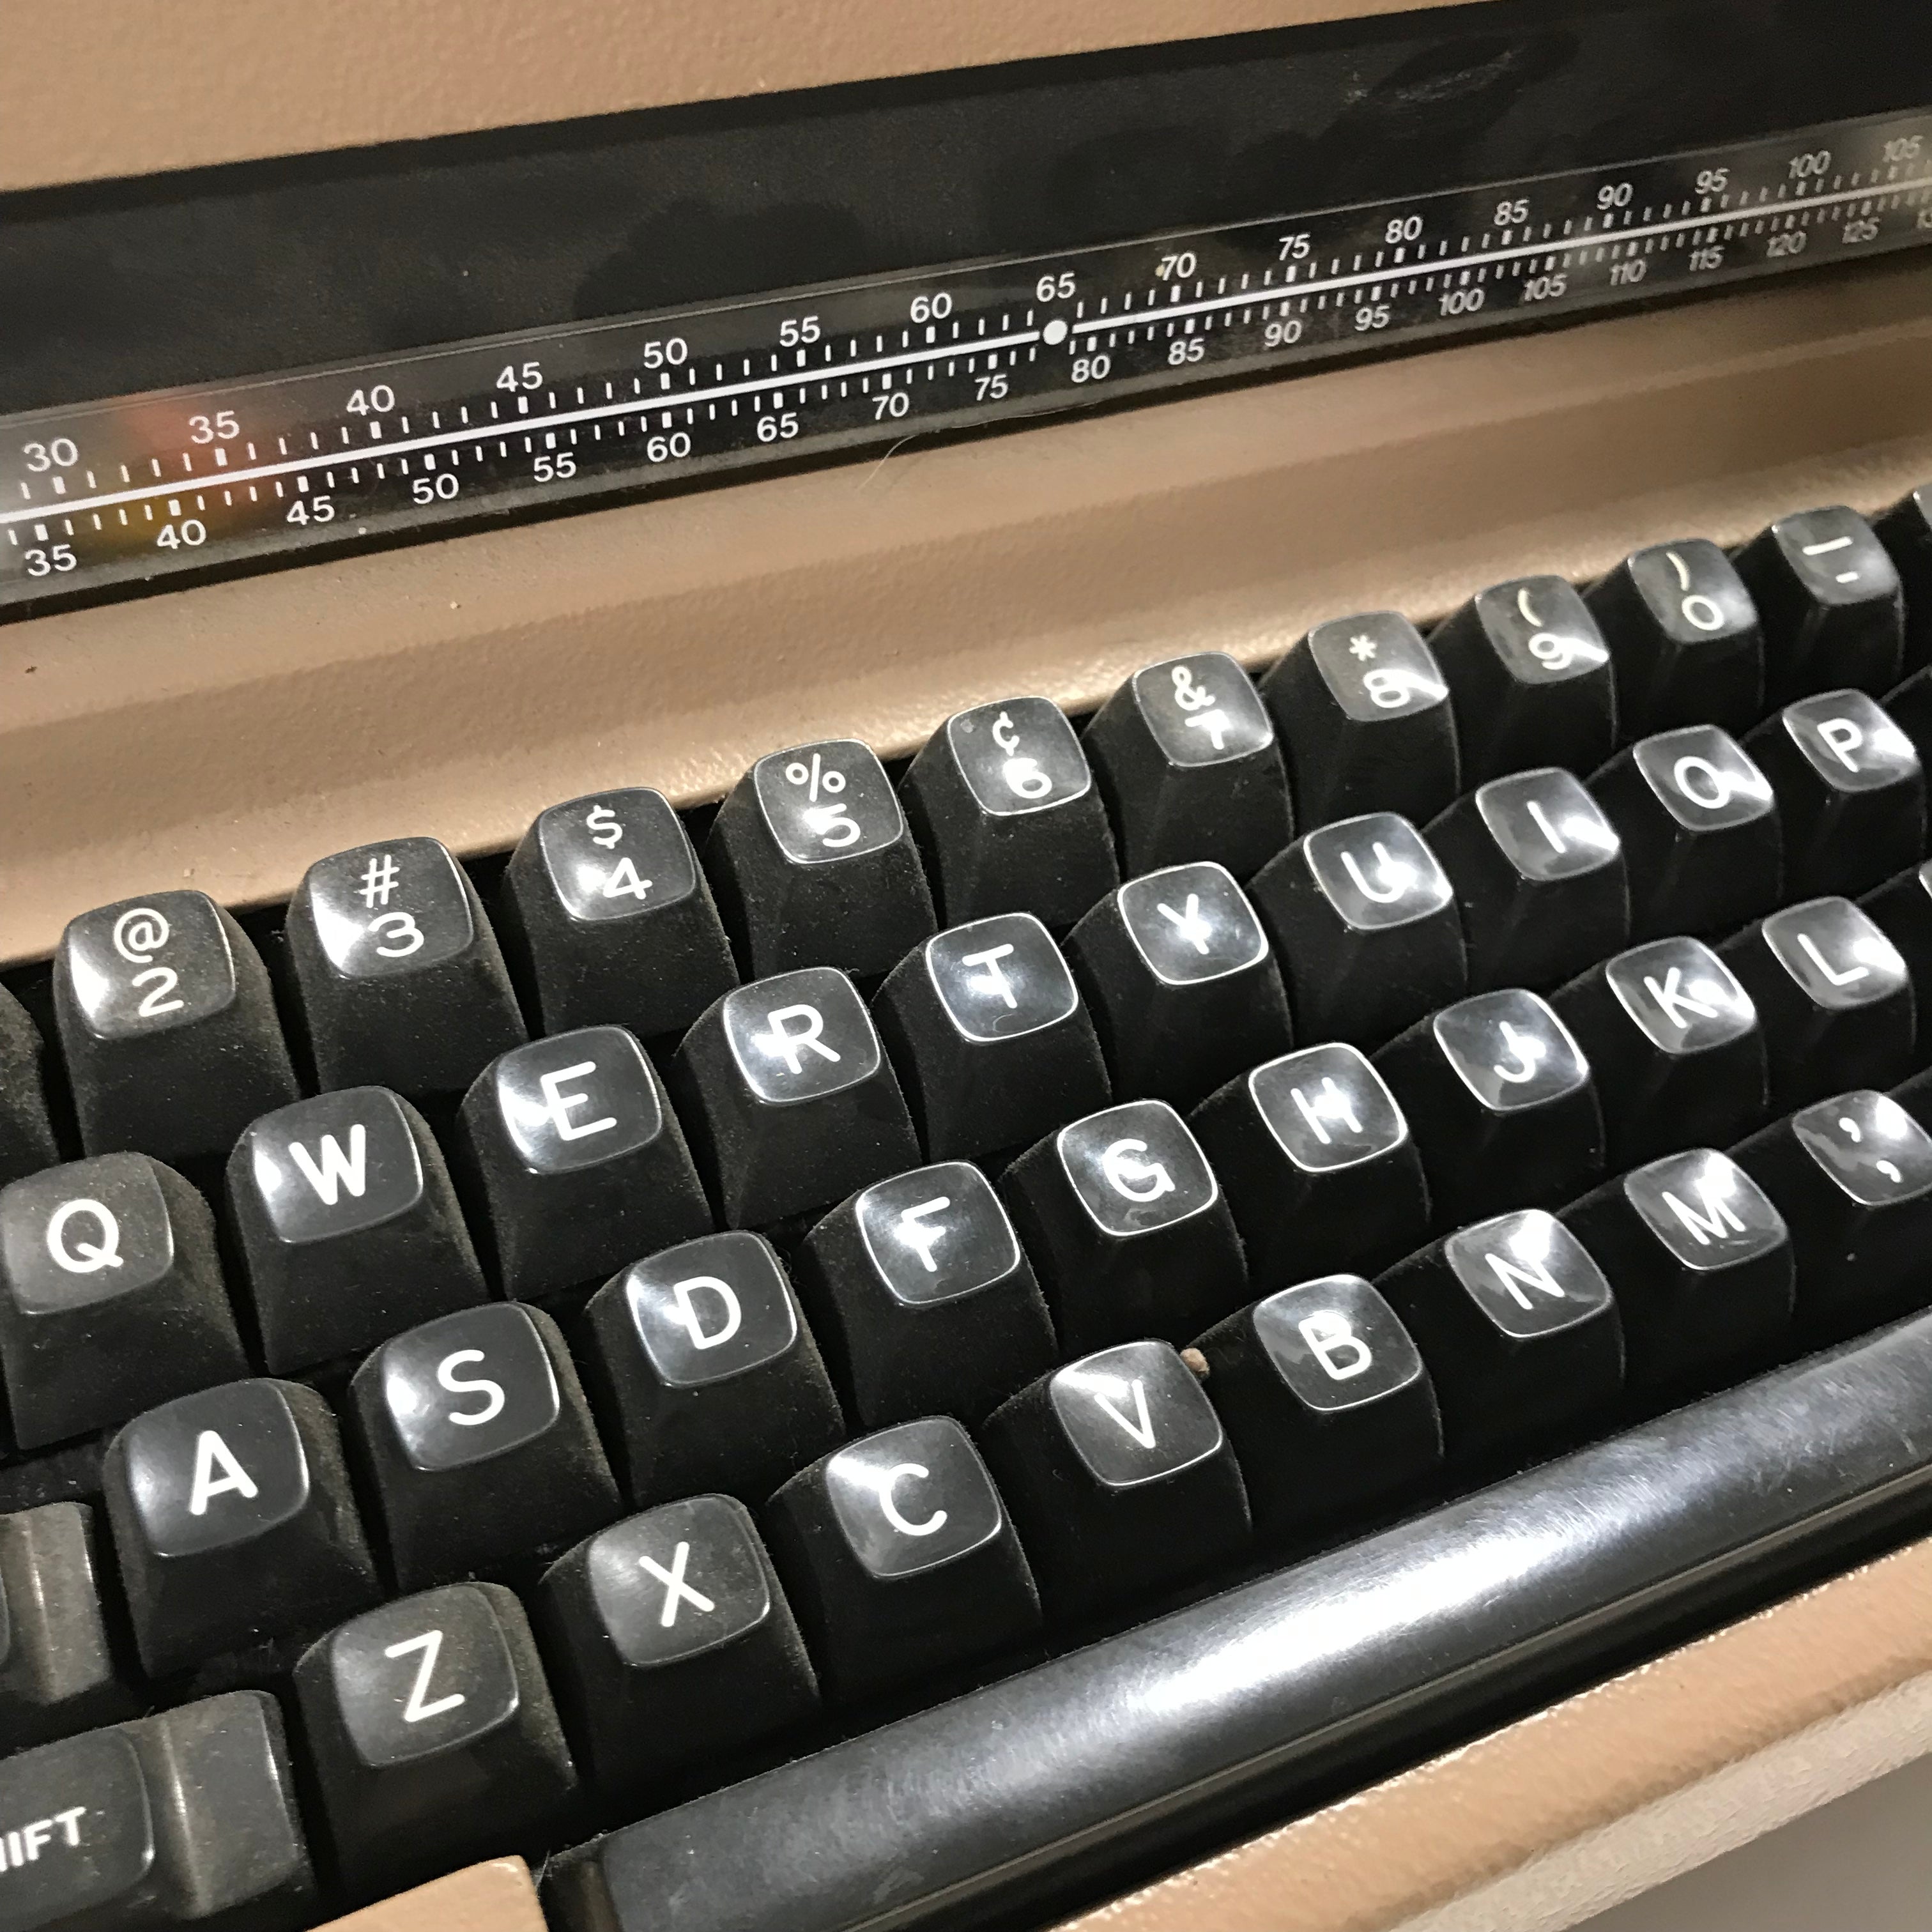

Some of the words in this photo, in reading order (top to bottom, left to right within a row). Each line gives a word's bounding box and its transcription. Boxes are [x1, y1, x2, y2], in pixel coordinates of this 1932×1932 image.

[23, 438, 79, 472] 30
[188, 410, 240, 445] 35
[346, 385, 395, 416] 40
[496, 362, 543, 392] 45
[643, 338, 688, 369] 50
[779, 316, 821, 347] 55
[910, 292, 953, 323] 60
[1036, 273, 1076, 303] 65
[1161, 252, 1196, 281] 70
[1278, 234, 1310, 261] 75
[1385, 215, 1423, 244] 80
[1494, 199, 1529, 226] 85
[1597, 182, 1633, 210] 90
[1696, 168, 1730, 194] 95
[1790, 150, 1831, 180] 100
[24, 544, 77, 578] 35
[156, 519, 207, 550] 40
[286, 495, 335, 526] 45
[412, 473, 459, 505] 50
[533, 452, 576, 482] 55
[646, 432, 691, 463] 60
[756, 411, 799, 443] 65
[872, 392, 910, 420] 70
[975, 374, 1009, 401] 75
[1071, 354, 1111, 383] 80
[1169, 338, 1205, 365] 85
[1264, 320, 1302, 348] 90
[1354, 304, 1390, 332] 95
[1438, 288, 1485, 316] 100
[1523, 273, 1567, 302] 105
[1610, 259, 1646, 286] 110
[1689, 246, 1725, 271] 115
[1767, 231, 1807, 257] 120
[1666, 551, 1690, 591] )
[1517, 588, 1544, 627] (
[1528, 632, 1573, 670] 9
[1171, 666, 1215, 710] &
[1363, 669, 1410, 709] 8
[1185, 709, 1230, 750] 7
[1816, 718, 1862, 773] P
[785, 753, 846, 802] %
[1003, 758, 1052, 799] 6
[1673, 756, 1731, 809] O
[586, 805, 622, 849] $
[815, 803, 861, 847] 5
[1528, 801, 1566, 854] I
[359, 854, 400, 908] #
[603, 857, 652, 900] 4
[1340, 842, 1410, 903] U
[113, 907, 169, 963] @
[367, 912, 424, 957] 3
[1156, 894, 1210, 954] Y
[962, 944, 1018, 1009] T
[1797, 933, 1869, 985] L
[132, 967, 185, 1017] 2
[1644, 967, 1718, 1029] K
[767, 1004, 841, 1075] R
[1493, 1021, 1535, 1083] J
[540, 1061, 617, 1141] E
[1290, 1077, 1363, 1145] H
[288, 1124, 366, 1206] W
[1103, 1138, 1176, 1202] G
[46, 1199, 124, 1273] Q
[901, 1196, 951, 1273] F
[1662, 1184, 1746, 1245] M
[1485, 1238, 1565, 1310] N
[673, 1276, 742, 1349] D
[1298, 1310, 1372, 1380] B
[436, 1349, 505, 1426] S
[1094, 1379, 1156, 1449] V
[188, 1430, 258, 1515] A
[879, 1463, 947, 1536] C
[639, 1541, 715, 1628] X
[385, 1630, 466, 1723] Z
